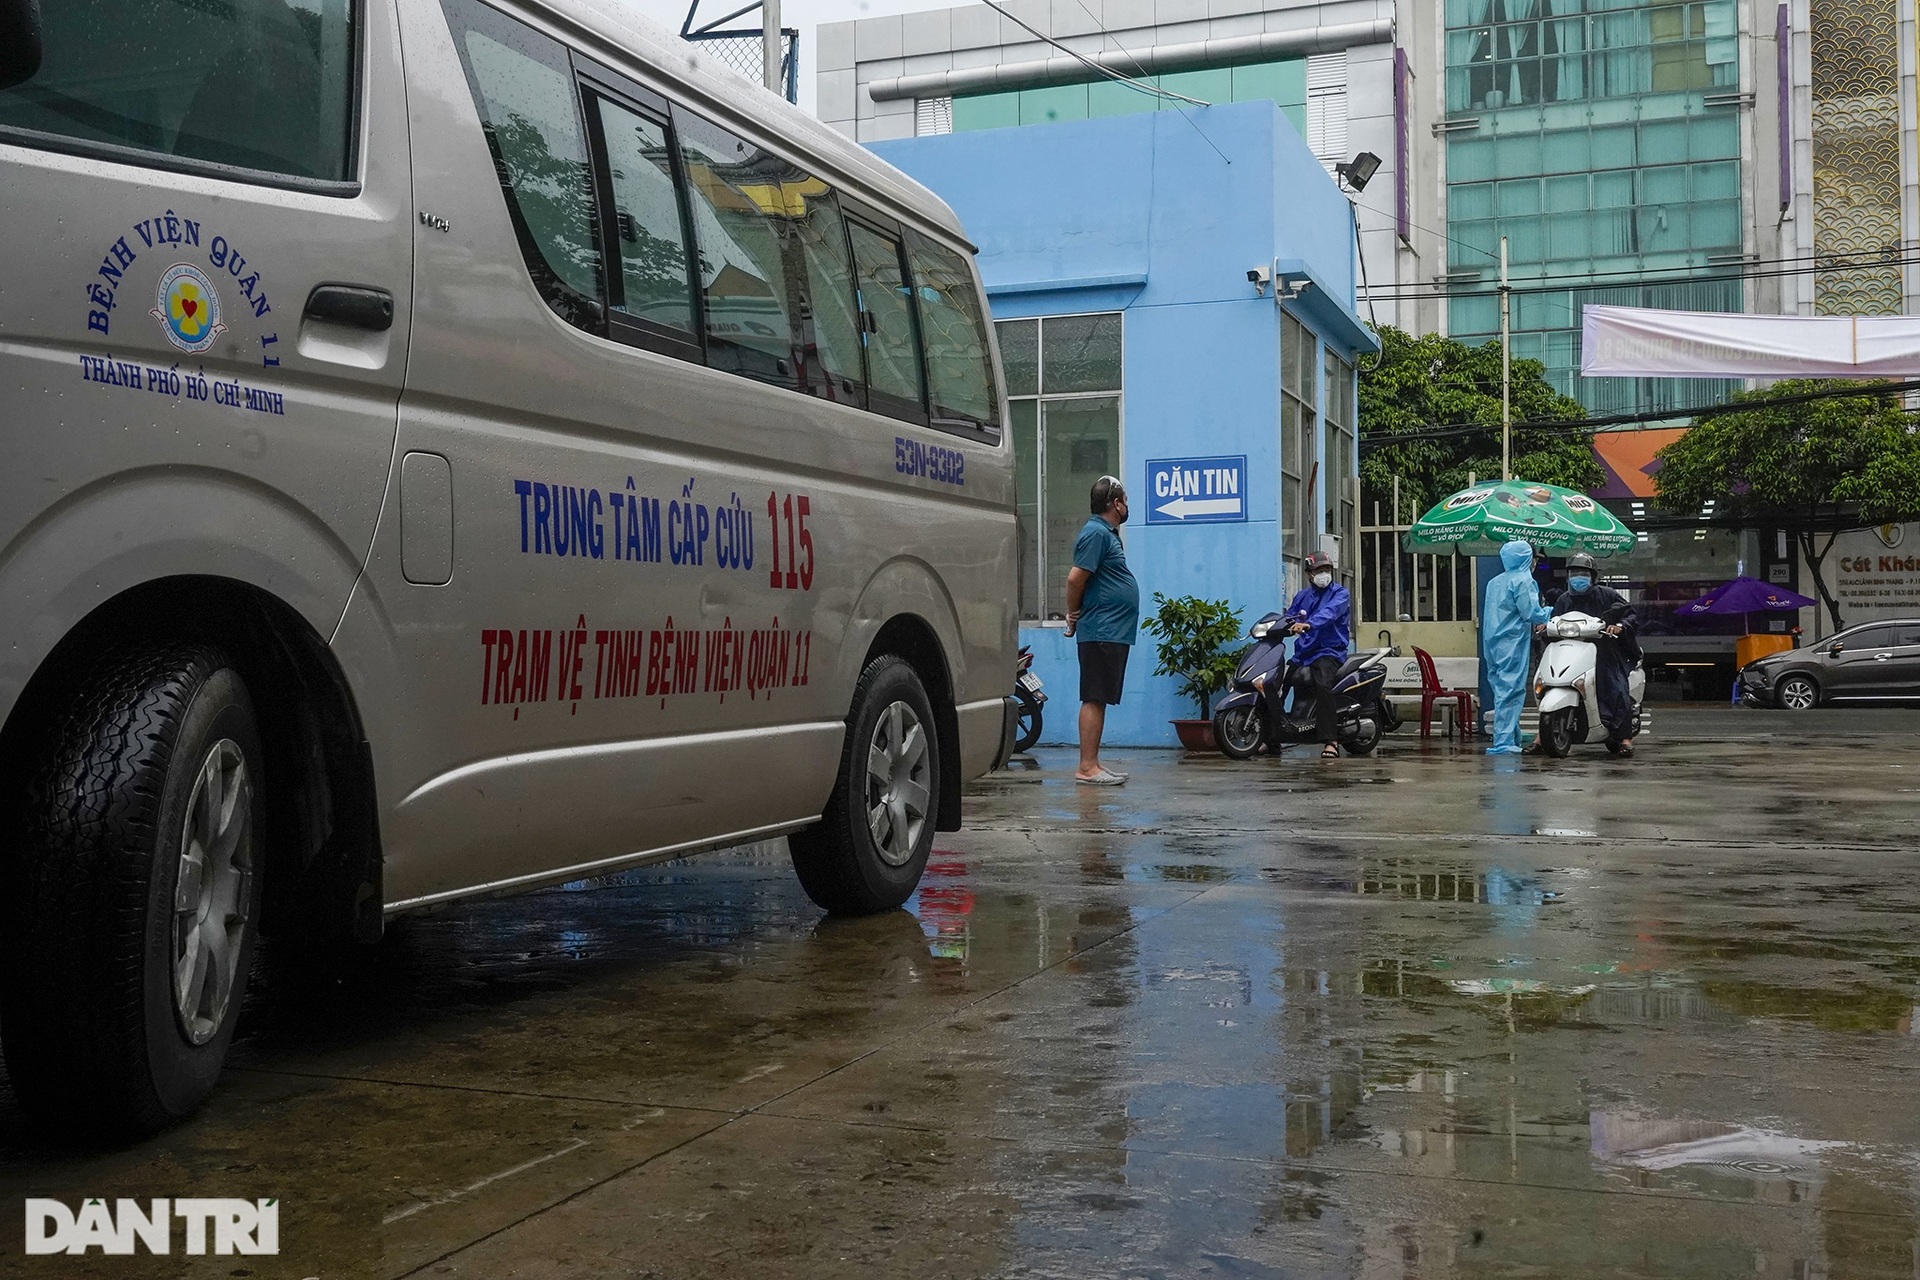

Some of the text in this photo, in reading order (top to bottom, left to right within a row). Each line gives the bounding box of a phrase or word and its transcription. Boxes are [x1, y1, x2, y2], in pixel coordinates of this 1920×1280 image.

[86, 235, 137, 336] BỆNH
[133, 209, 201, 249] VIỆN
[209, 235, 271, 318] QUẬN
[80, 353, 285, 416] THÀNH PHỐ HỒ CHÍ MINH
[895, 436, 965, 486] 53N-9302
[1155, 466, 1238, 498] CĂN TIN
[1565, 499, 1592, 509] MILO
[515, 476, 814, 591] TRUNG TÂM CẤP CỨU 115
[1492, 525, 1513, 534] MILO
[1513, 527, 1538, 537] NĂNG
[1840, 556, 1871, 573] Cát
[481, 614, 812, 721] TRẠM VỆ TINH BỆNH VIỆN QUẬN 11
